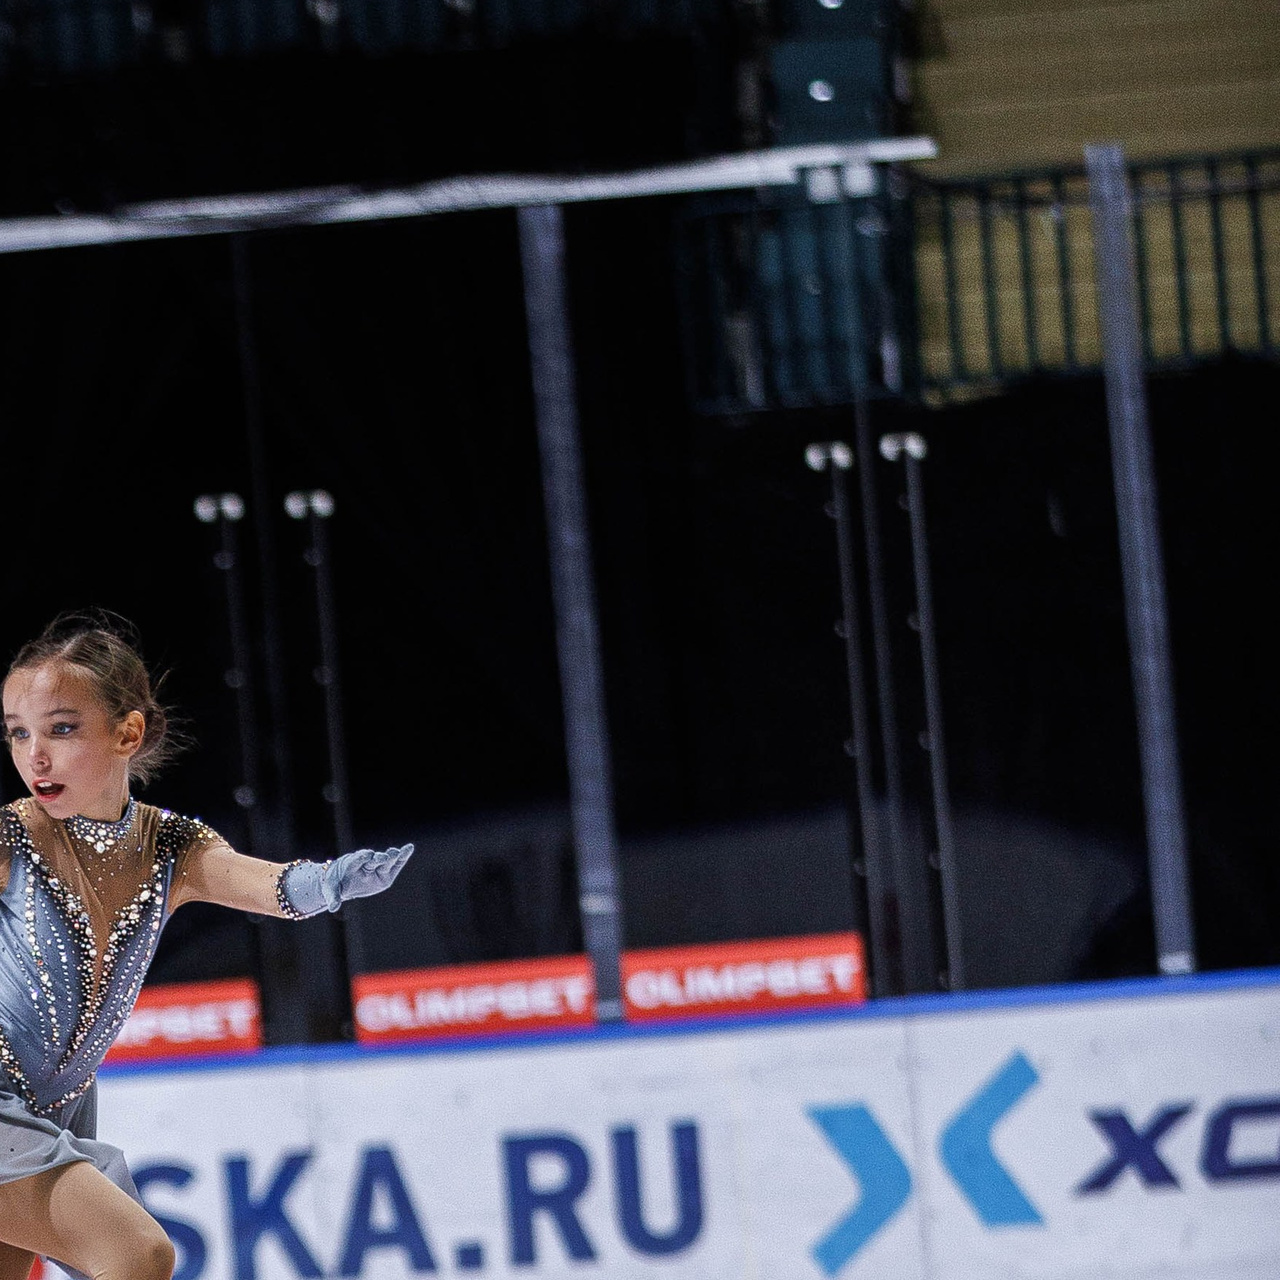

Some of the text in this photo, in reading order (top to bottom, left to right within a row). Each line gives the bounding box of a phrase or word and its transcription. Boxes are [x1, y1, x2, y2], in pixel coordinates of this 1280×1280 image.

[355, 975, 591, 1033] OLIMPBET
[626, 954, 859, 1009] OLIMPBET
[116, 999, 257, 1046] PBET
